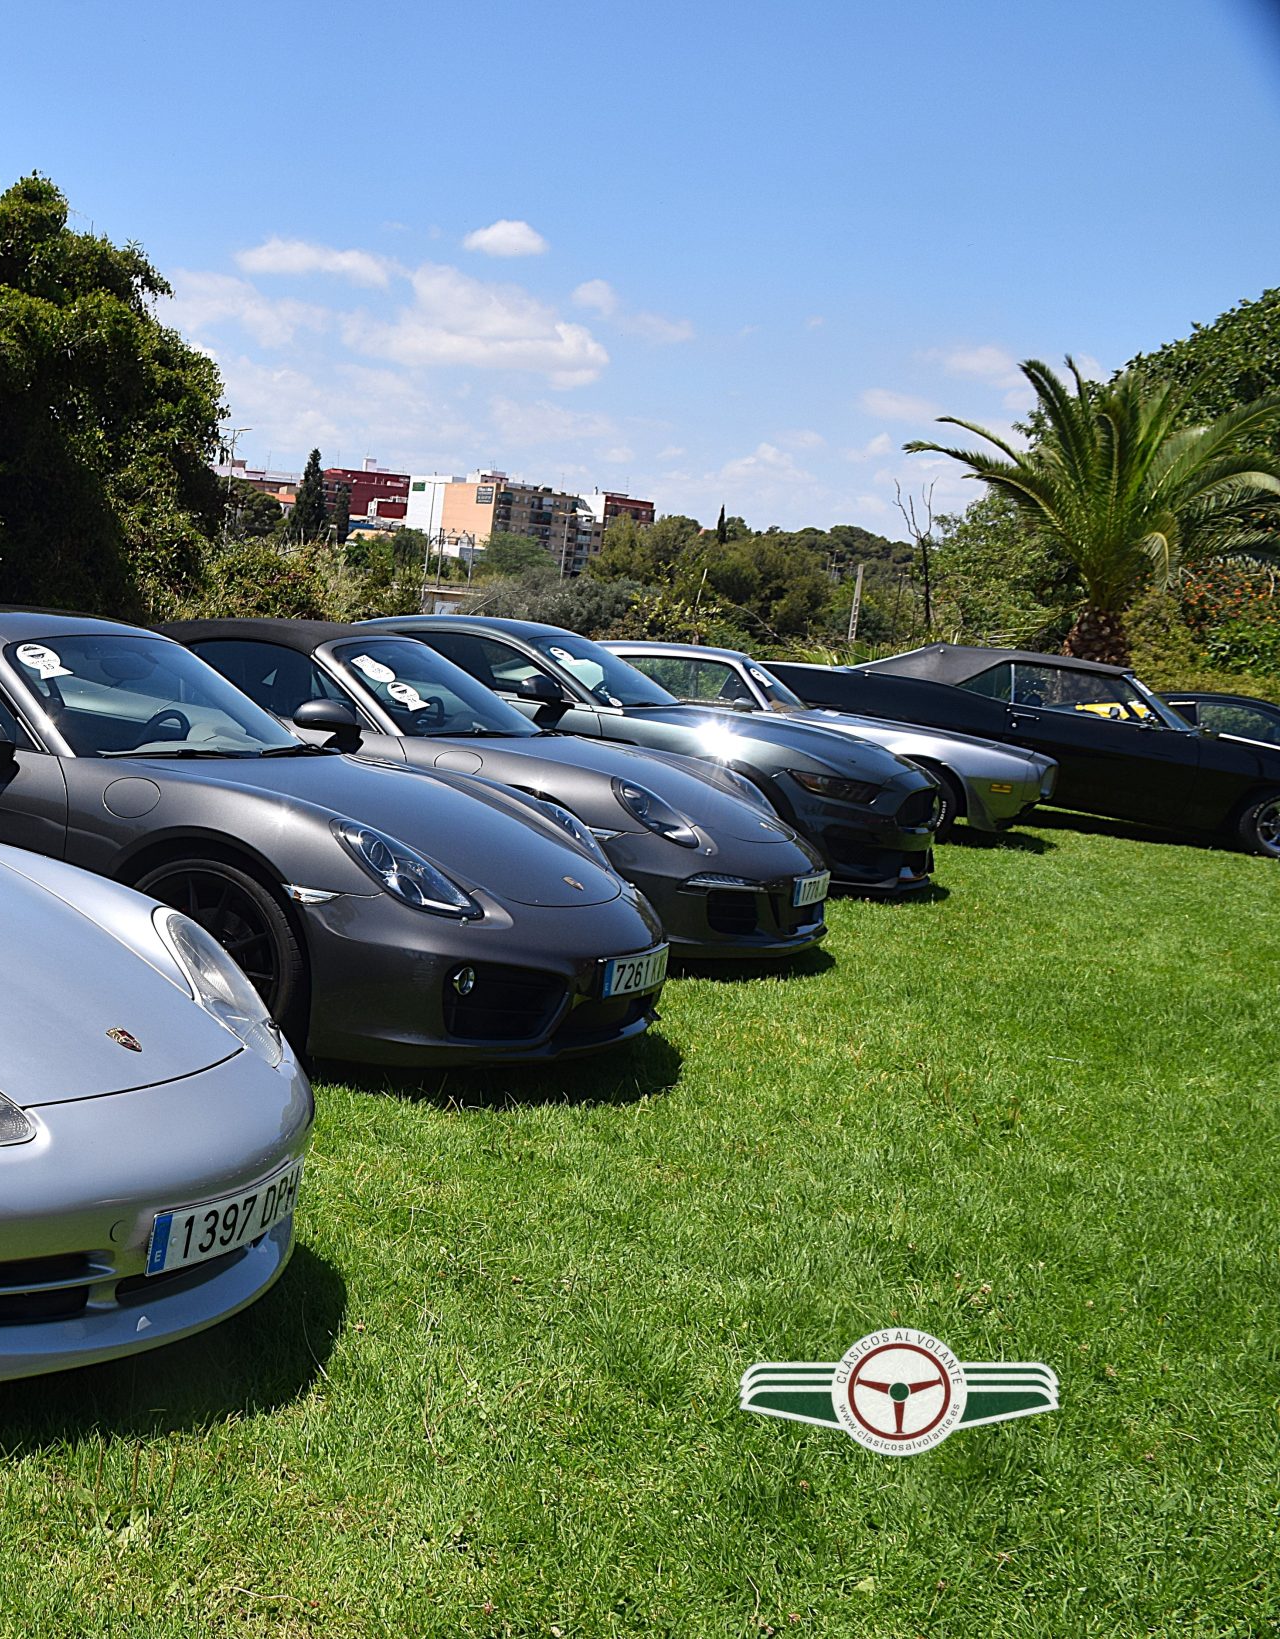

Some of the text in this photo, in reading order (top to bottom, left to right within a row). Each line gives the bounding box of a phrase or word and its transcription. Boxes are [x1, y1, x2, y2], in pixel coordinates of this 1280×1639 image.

[614, 959, 650, 991] 7261
[183, 1165, 301, 1259] 1397 DPH
